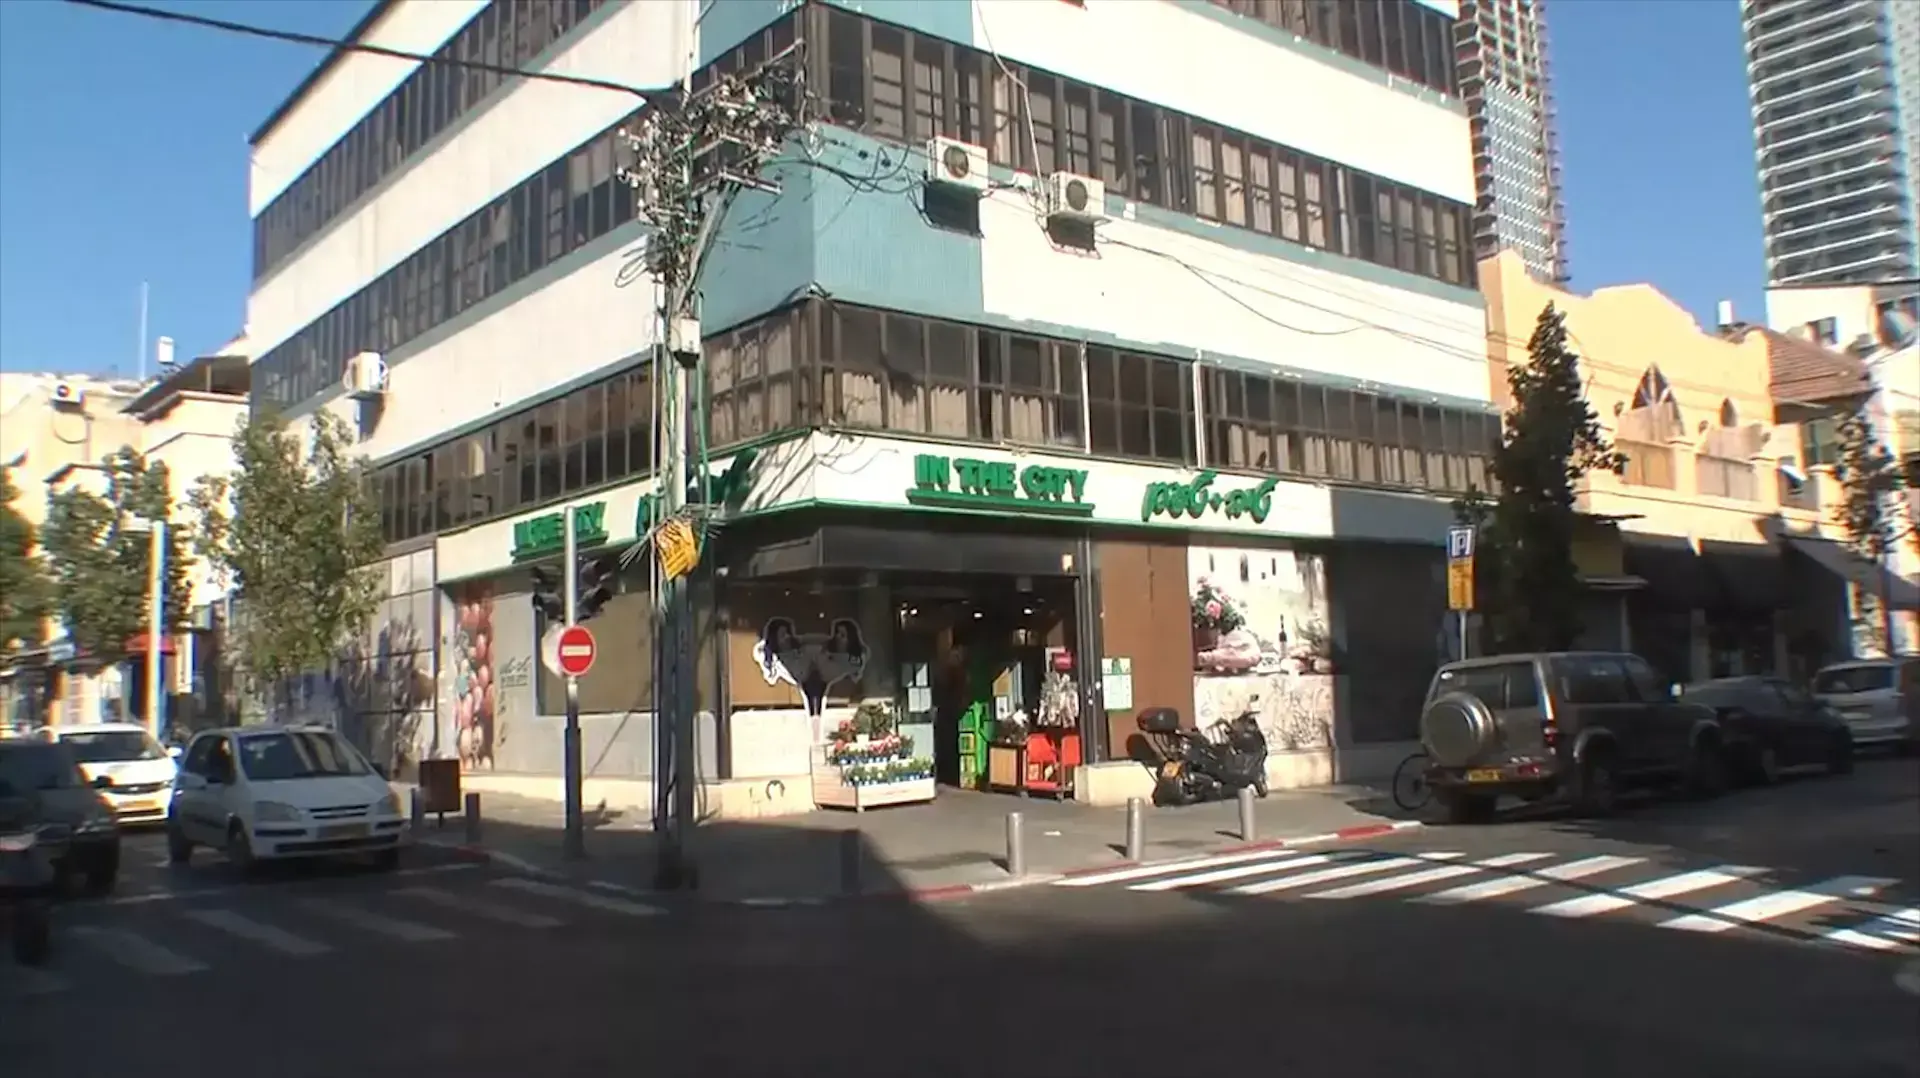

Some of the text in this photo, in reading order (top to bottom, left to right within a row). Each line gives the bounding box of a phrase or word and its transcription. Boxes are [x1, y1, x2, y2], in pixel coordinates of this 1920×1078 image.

[914, 454, 1089, 504] IN THE CITY
